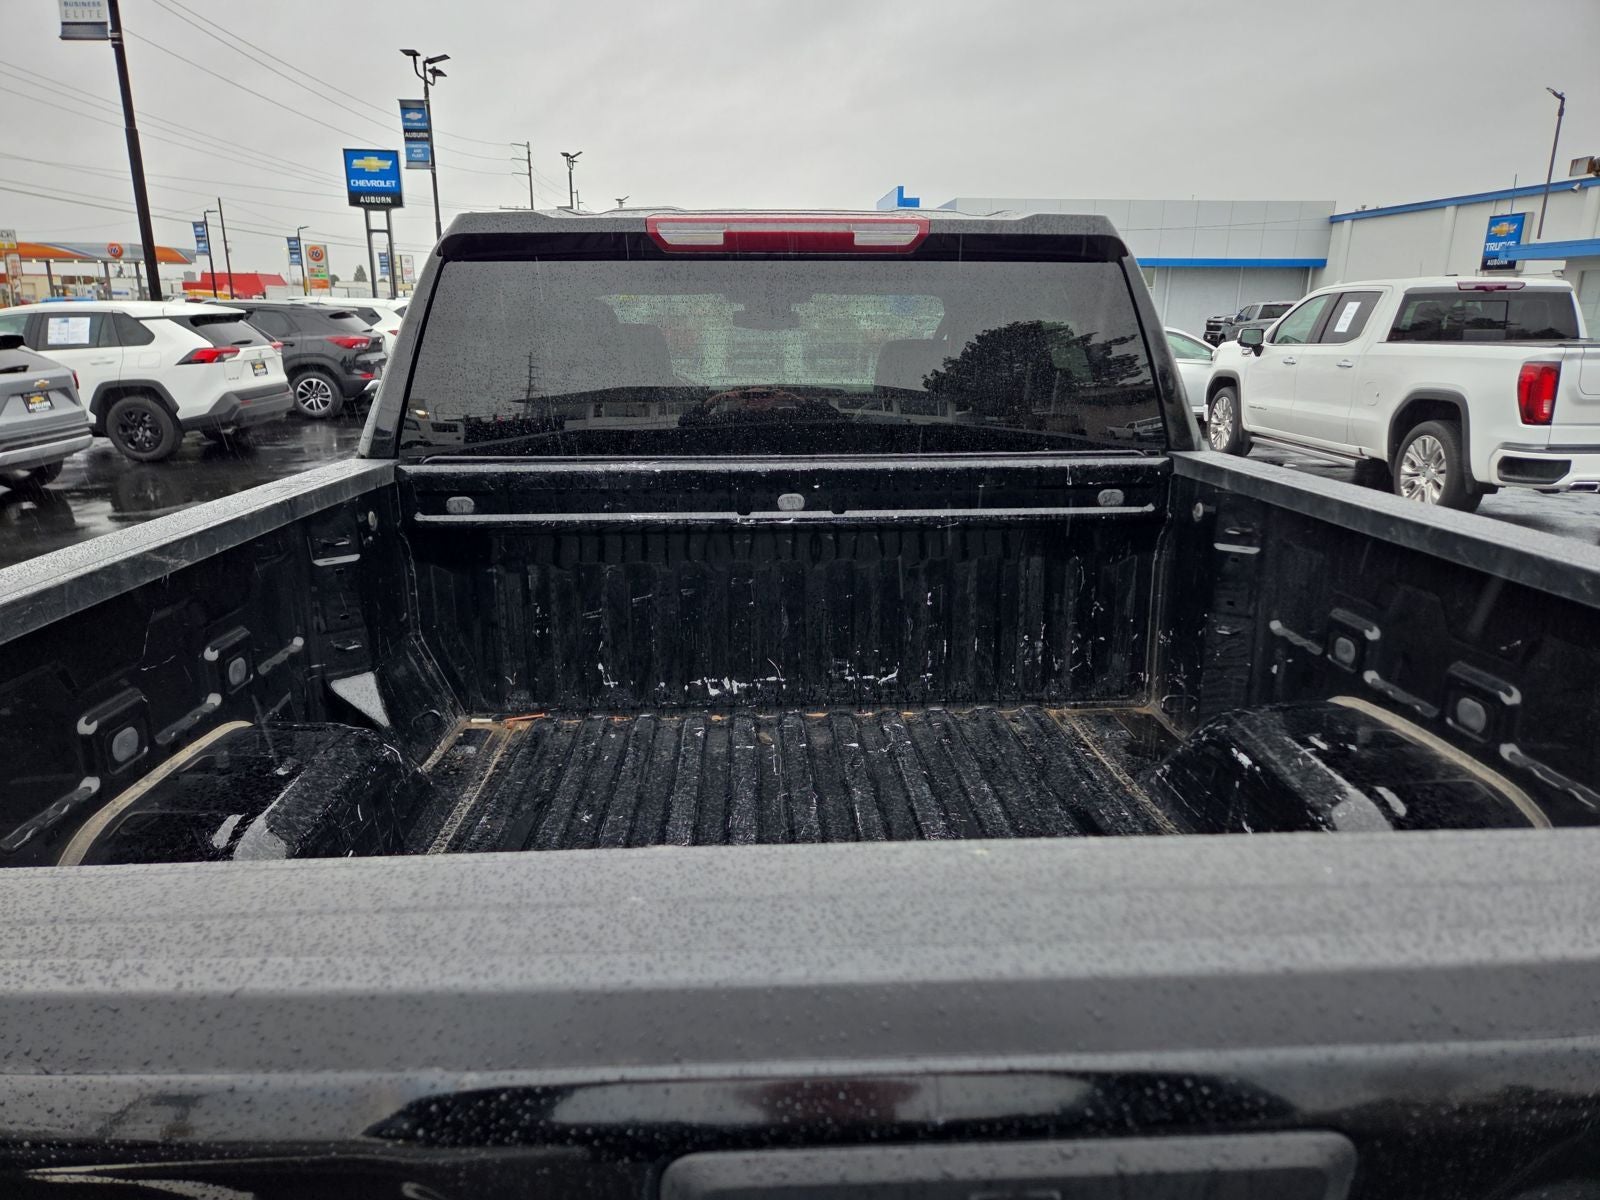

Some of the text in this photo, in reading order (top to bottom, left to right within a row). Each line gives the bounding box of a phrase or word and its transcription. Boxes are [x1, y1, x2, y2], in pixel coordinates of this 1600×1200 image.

[64, 9, 102, 19] ELITE
[350, 179, 396, 188] CHEVROLET
[360, 195, 392, 204] AUBURN
[311, 250, 320, 258] 76
